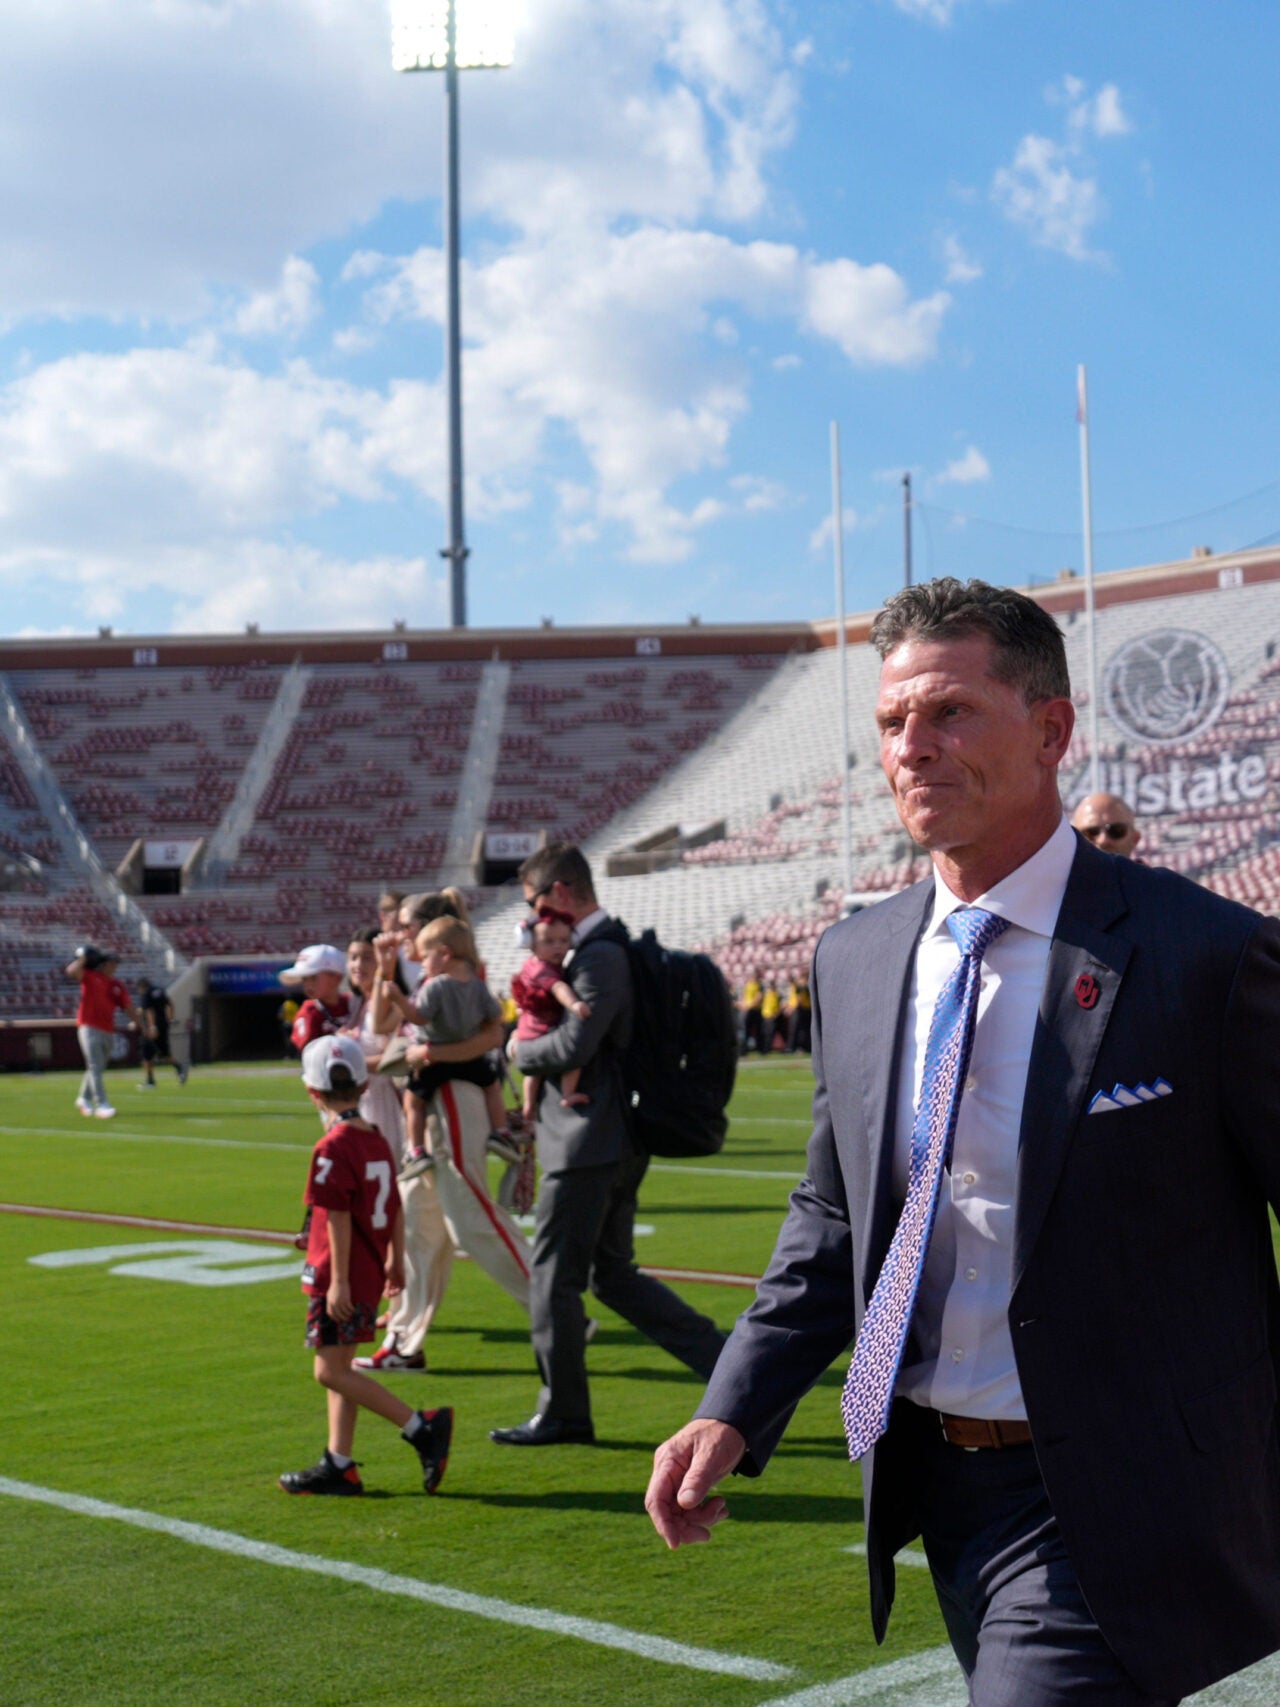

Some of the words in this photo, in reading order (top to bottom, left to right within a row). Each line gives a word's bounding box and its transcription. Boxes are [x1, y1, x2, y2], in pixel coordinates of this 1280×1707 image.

[1066, 750, 1269, 814] Allstate
[1074, 973, 1099, 1009] OU
[315, 1156, 334, 1184] 7
[365, 1160, 391, 1230] 7
